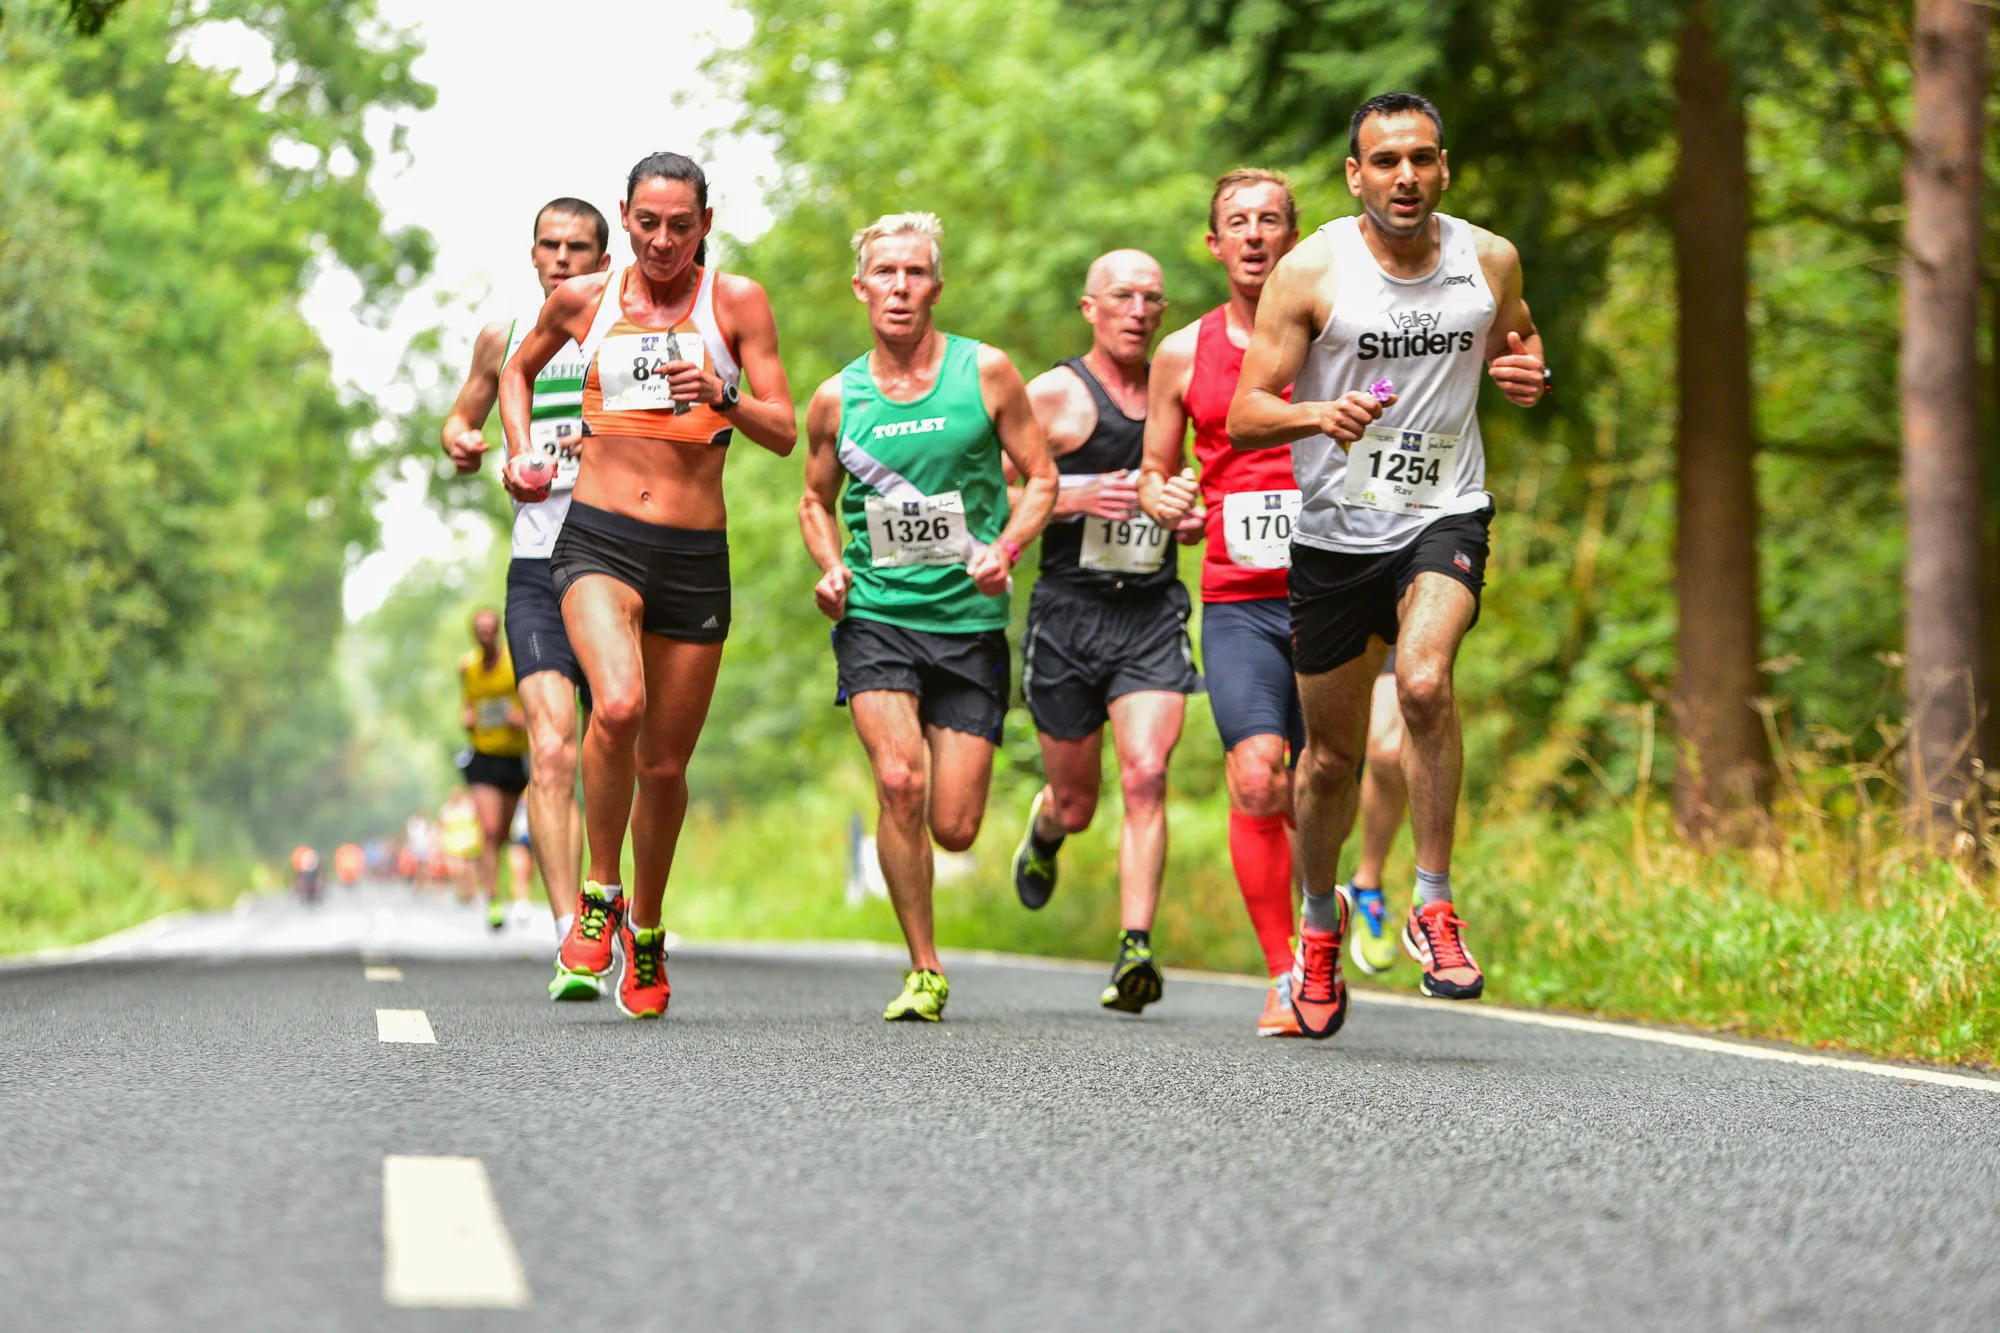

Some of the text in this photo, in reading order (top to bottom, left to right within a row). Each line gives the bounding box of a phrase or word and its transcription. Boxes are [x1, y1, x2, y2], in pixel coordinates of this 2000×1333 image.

[1388, 310, 1443, 331] Valley
[1357, 327, 1474, 361] Striders
[872, 416, 947, 440] TOTLEY
[1368, 449, 1441, 487] 1254
[882, 517, 950, 543] 1326
[1102, 521, 1161, 547] 1970
[1241, 514, 1298, 541] 170
